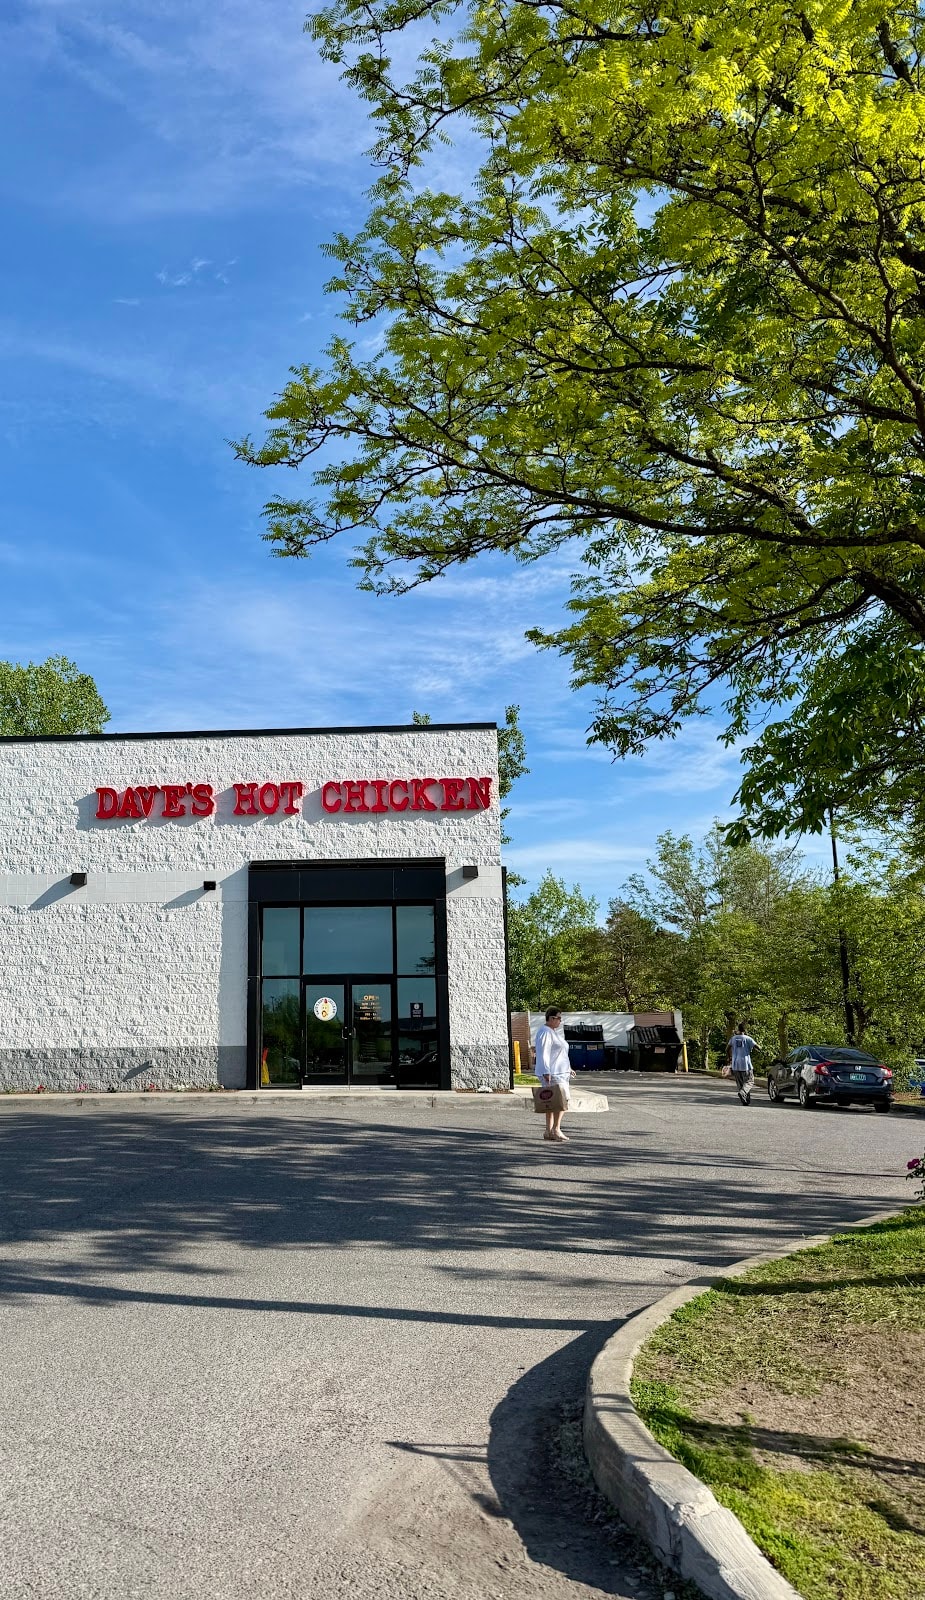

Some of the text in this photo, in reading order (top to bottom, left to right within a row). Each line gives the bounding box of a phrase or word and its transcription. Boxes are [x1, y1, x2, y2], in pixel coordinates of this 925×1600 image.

[95, 777, 492, 819] DAVE'S HOT CHICKEN
